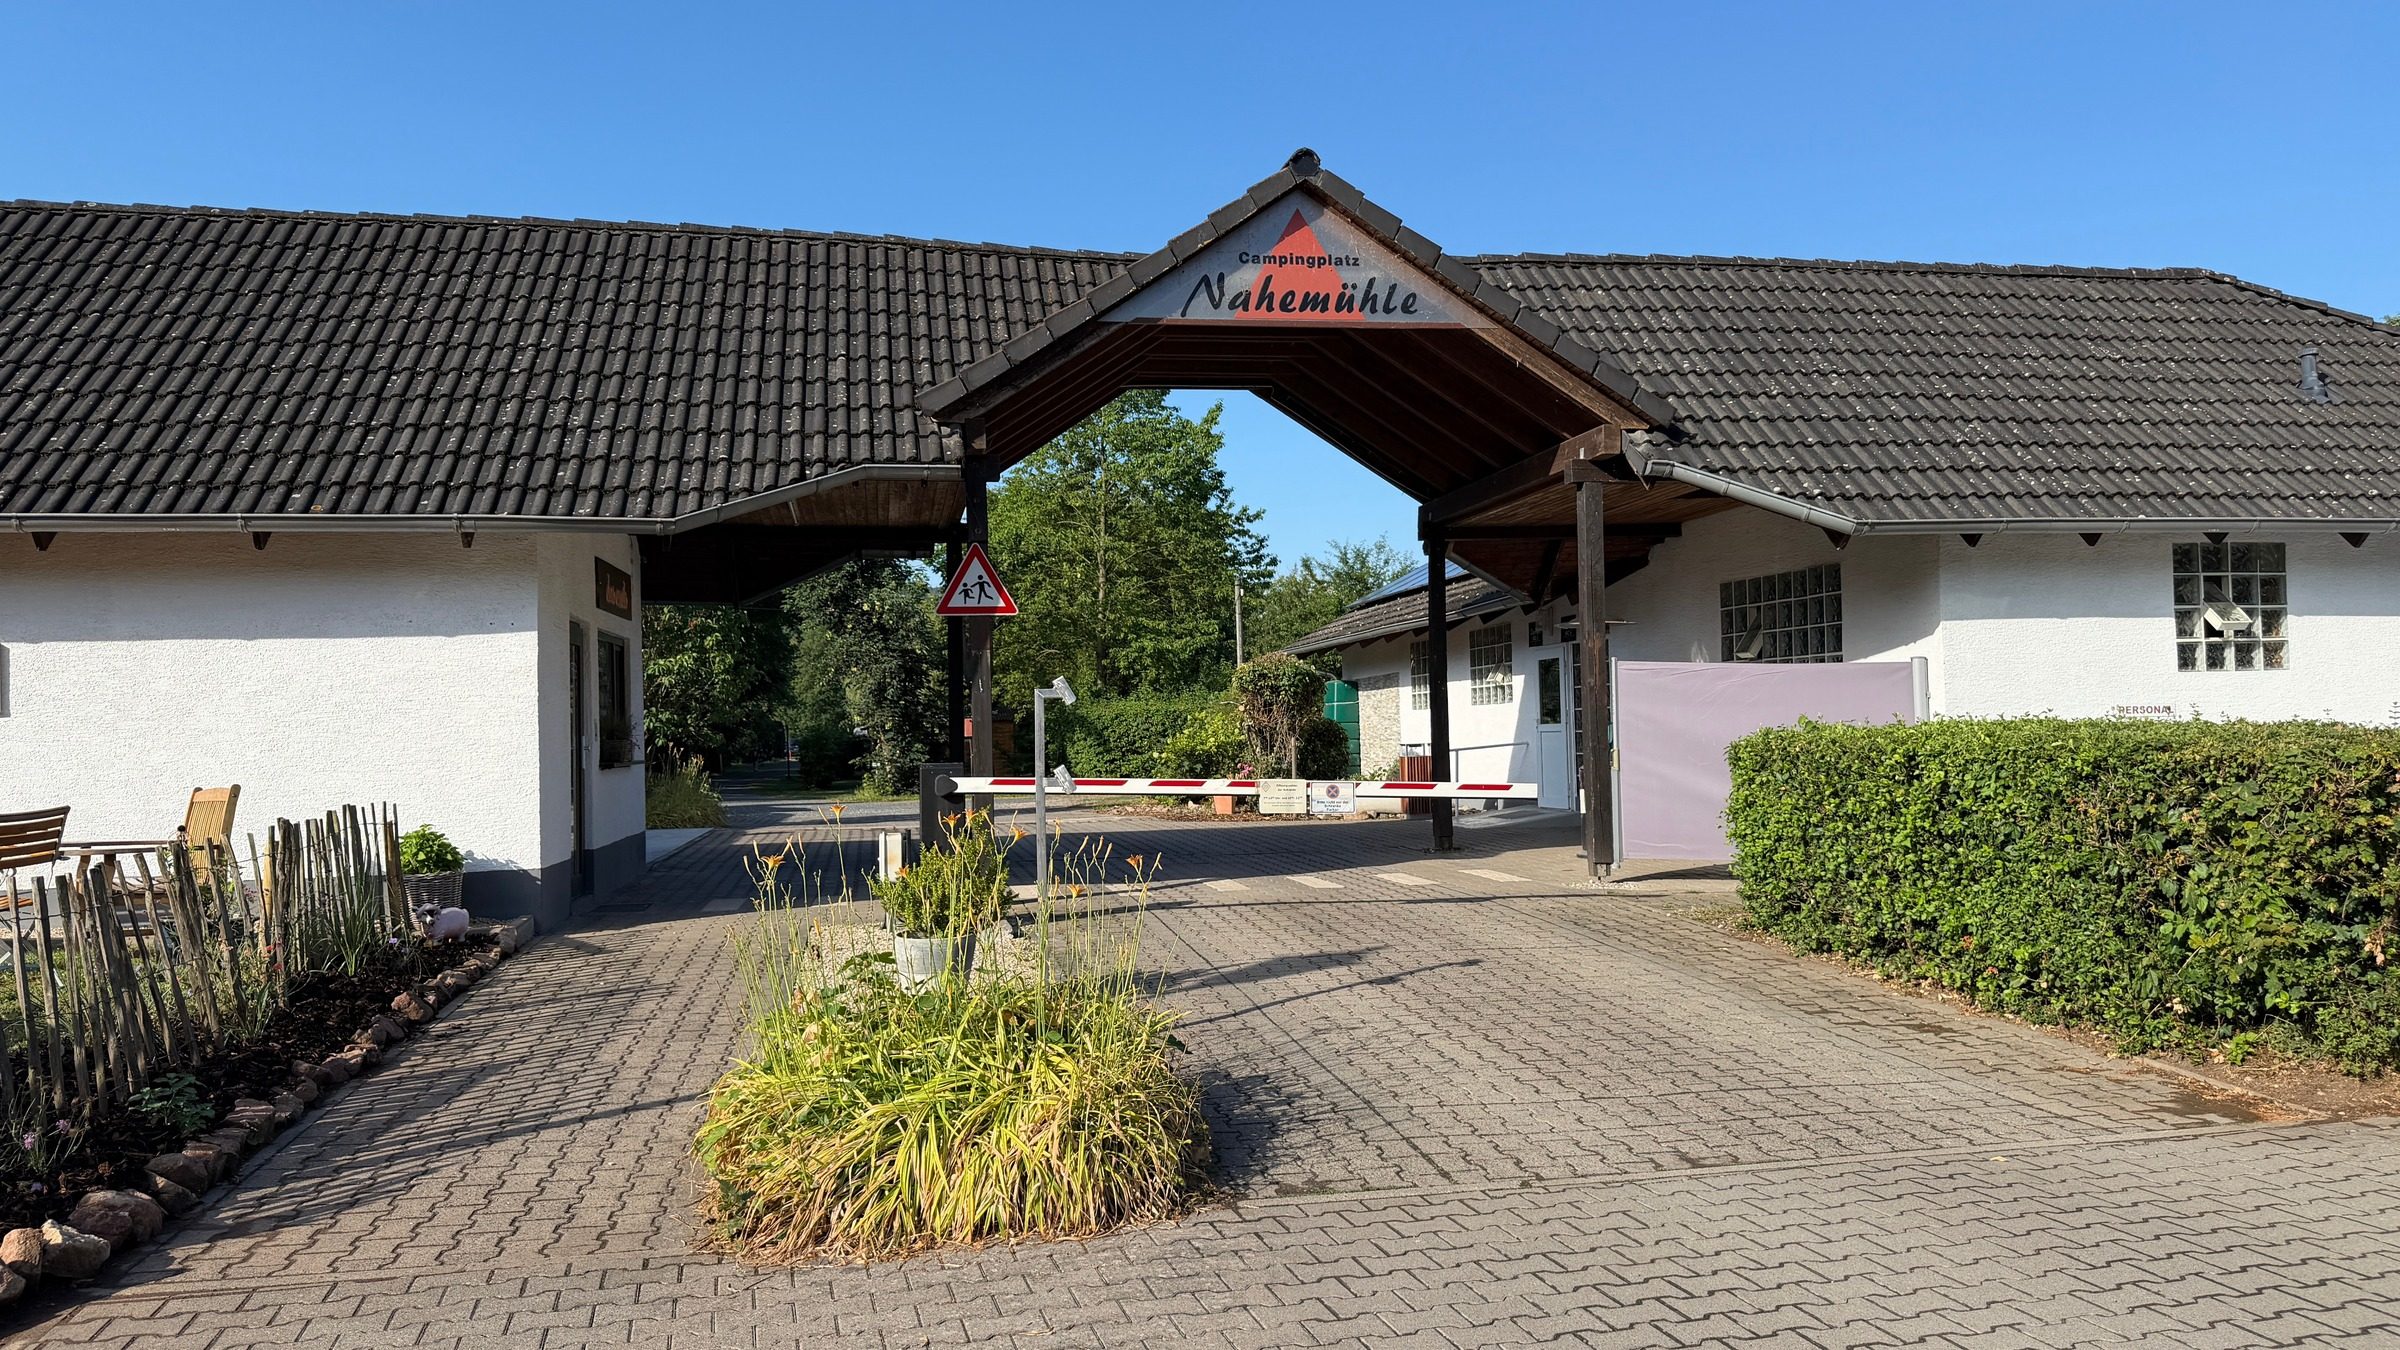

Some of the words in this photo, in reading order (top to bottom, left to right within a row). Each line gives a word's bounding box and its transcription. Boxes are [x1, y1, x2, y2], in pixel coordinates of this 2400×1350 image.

[1238, 251, 1360, 268] Campingplatz
[1180, 271, 1418, 317] Nahemühle
[2118, 705, 2174, 714] PERSONAL
